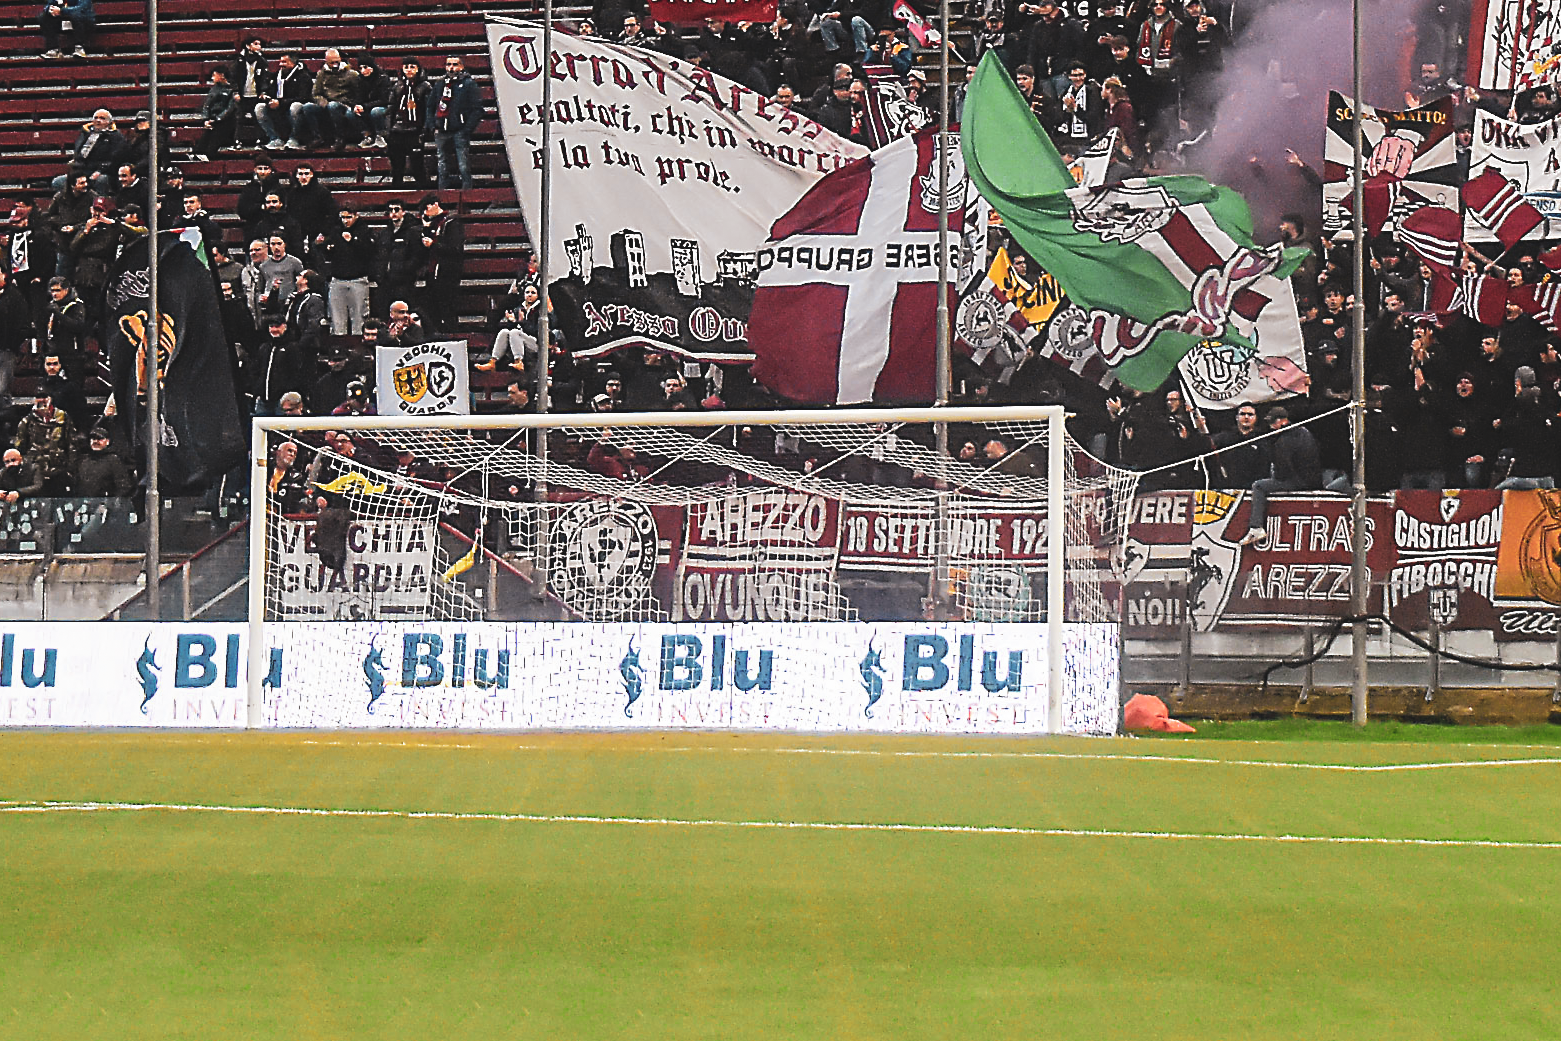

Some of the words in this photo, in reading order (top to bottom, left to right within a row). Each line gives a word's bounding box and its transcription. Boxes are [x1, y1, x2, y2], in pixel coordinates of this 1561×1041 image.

[499, 35, 638, 90] Terra
[559, 138, 591, 169] la
[703, 119, 737, 149] in
[583, 302, 679, 339] Arezzo
[396, 344, 453, 368] VECCHIA
[700, 493, 827, 542] AREZZO
[1394, 504, 1504, 548] CASTIGLION
[281, 524, 428, 554] VECHIA
[641, 540, 655, 571] 1923
[281, 562, 428, 593] GUARDIA
[684, 572, 828, 621] OVUNQUE
[174, 633, 283, 688] Blu
[402, 633, 510, 690] Blu
[659, 634, 773, 691] Blu
[902, 634, 1023, 692] Blu
[173, 698, 283, 720] INVET
